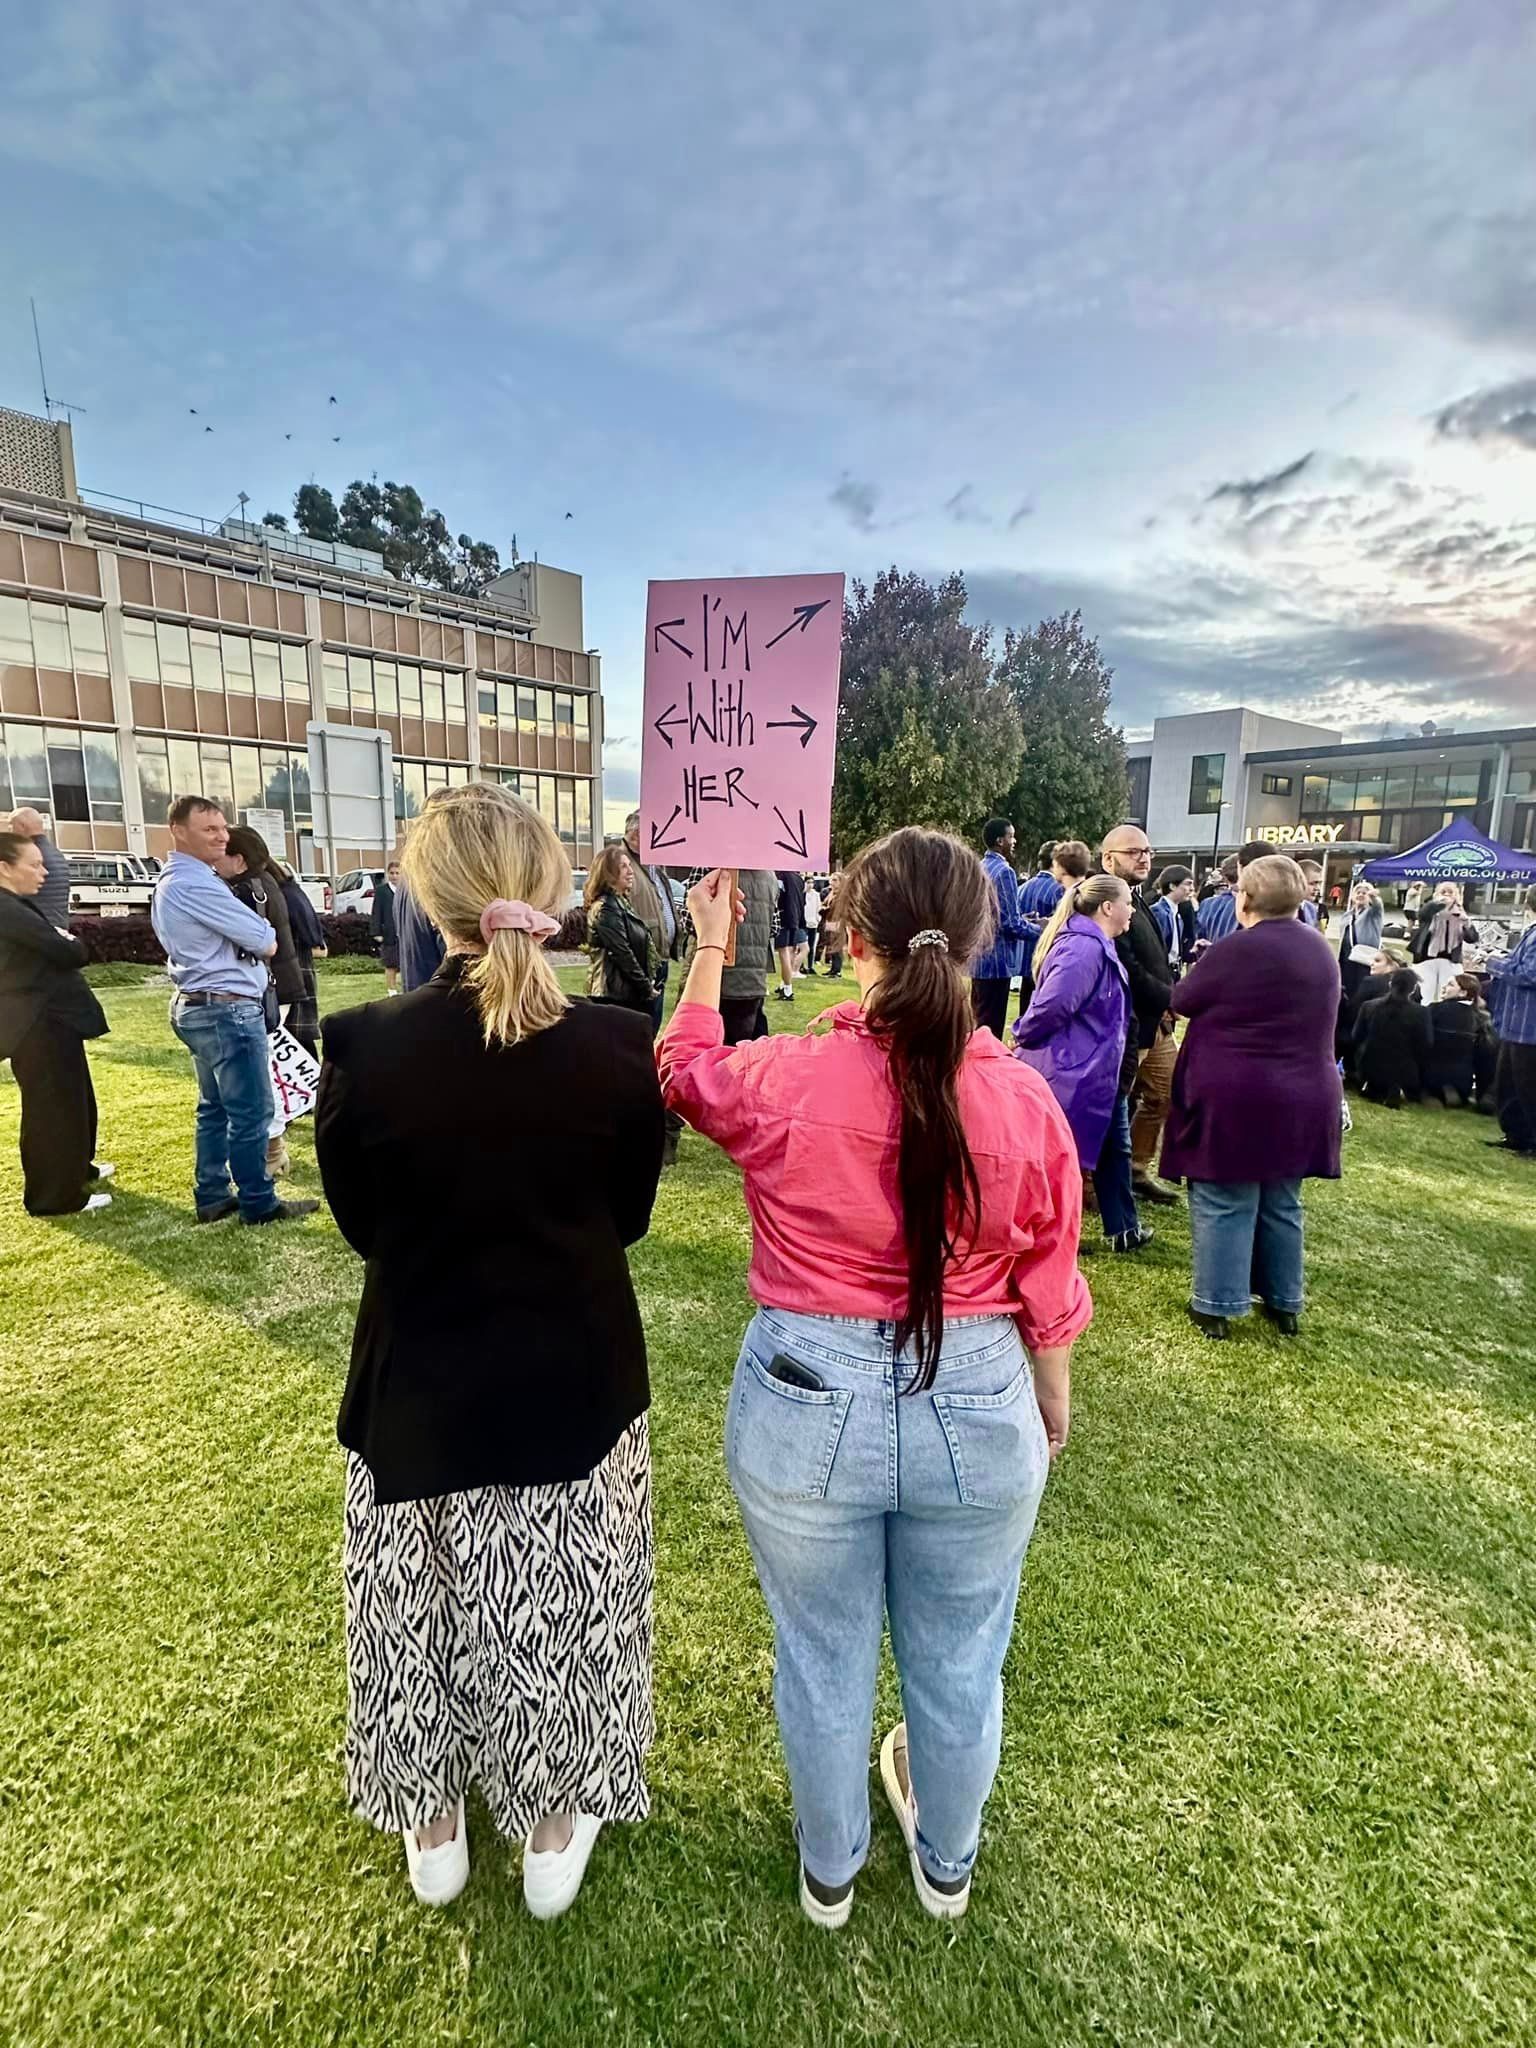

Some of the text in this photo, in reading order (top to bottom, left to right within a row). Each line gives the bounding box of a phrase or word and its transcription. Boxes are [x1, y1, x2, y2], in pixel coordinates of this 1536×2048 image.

[703, 594, 751, 671] I'M
[688, 679, 754, 747] With
[683, 765, 759, 823] HER
[1245, 824, 1345, 844] LIBRARY
[1403, 866, 1531, 880] www.dvac.org.au
